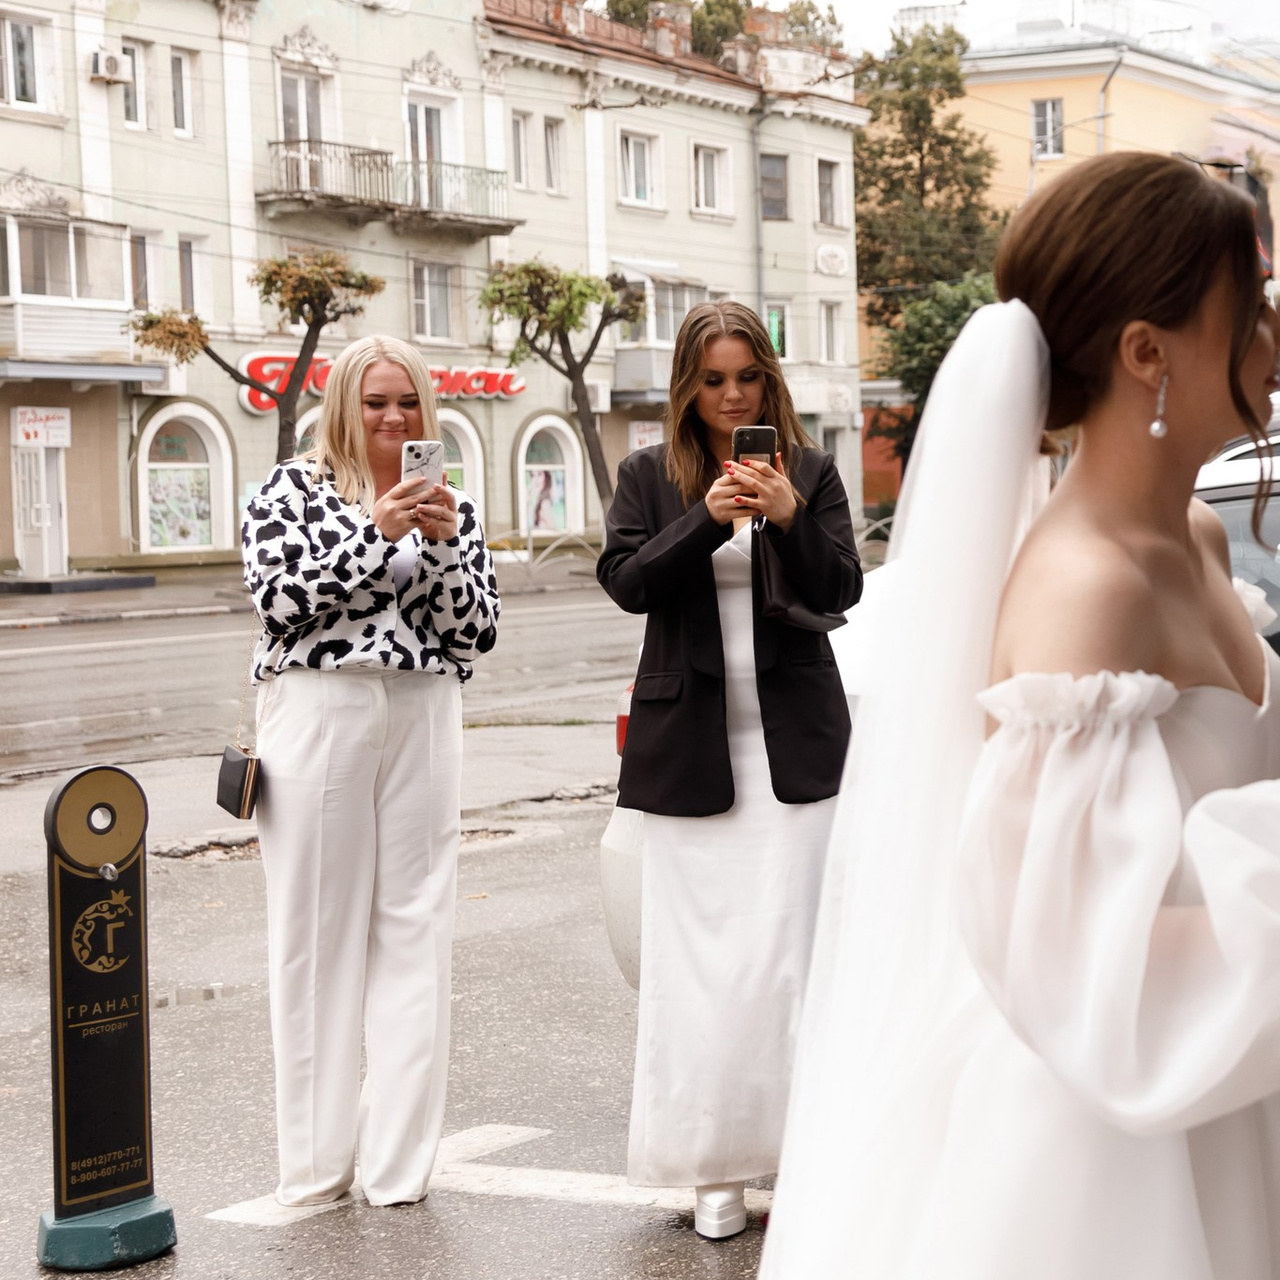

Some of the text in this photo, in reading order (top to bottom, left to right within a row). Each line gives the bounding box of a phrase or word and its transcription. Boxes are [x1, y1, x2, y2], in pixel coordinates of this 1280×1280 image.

[67, 994, 140, 1019] ГРАНАТ
[82, 1021, 129, 1038] ресторан
[70, 1145, 140, 1171] 8(4912)770-771
[70, 1157, 143, 1185] 8-900-607-77-77
